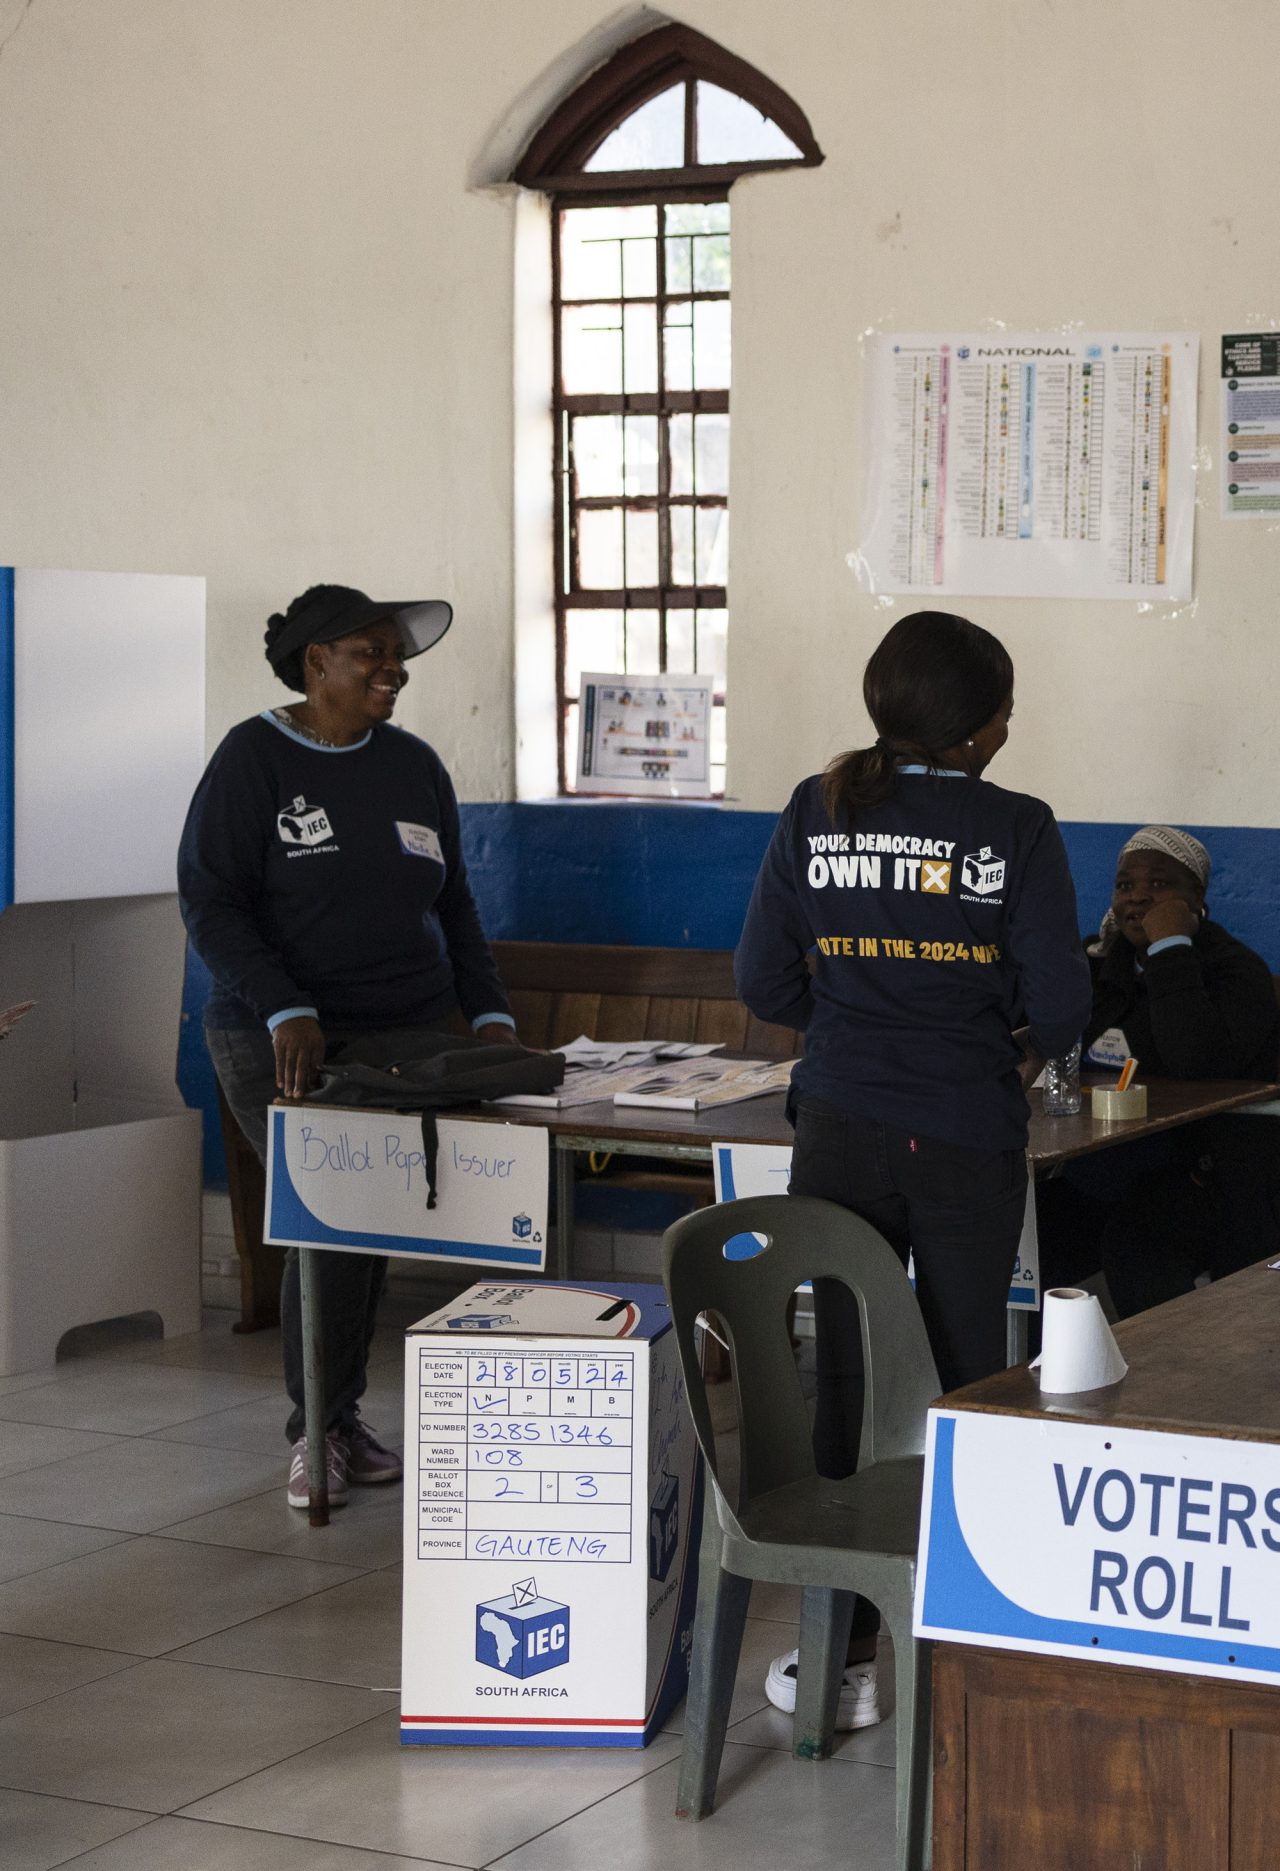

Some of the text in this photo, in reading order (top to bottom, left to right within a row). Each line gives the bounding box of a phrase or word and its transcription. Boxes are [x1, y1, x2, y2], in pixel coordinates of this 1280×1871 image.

[978, 347, 1076, 357] NATIONAL
[307, 816, 328, 836] IEC
[286, 844, 340, 859] SOUTH AFRICA
[808, 833, 956, 858] YOUR DEMOCRACY
[808, 855, 921, 891] OWN IT
[985, 868, 1003, 884] IEC
[960, 893, 1003, 905] SOUTH AFRICA
[858, 937, 878, 957] IN
[881, 939, 915, 959] THE
[920, 941, 969, 961] 2024
[300, 1126, 516, 1191] Ballot Pape Issuer
[476, 1364, 628, 1388] 2 8 0 5 2 4
[424, 1391, 463, 1399] ELECTION
[485, 1394, 492, 1402] N
[567, 1396, 575, 1404] M
[433, 1400, 453, 1408] TYPE
[432, 1424, 466, 1432] NUMBER
[431, 1448, 455, 1456] WARD
[474, 1449, 523, 1466] 108
[422, 1490, 464, 1498] SEQUENCE
[495, 1477, 524, 1497] 2
[575, 1475, 598, 1498] 3
[431, 1515, 453, 1523] CODE
[475, 1534, 607, 1559] GAUTENG
[1089, 1549, 1250, 1631] ROLL
[527, 1623, 565, 1658] IEC
[475, 1686, 569, 1697] SOUTH AFRICA
